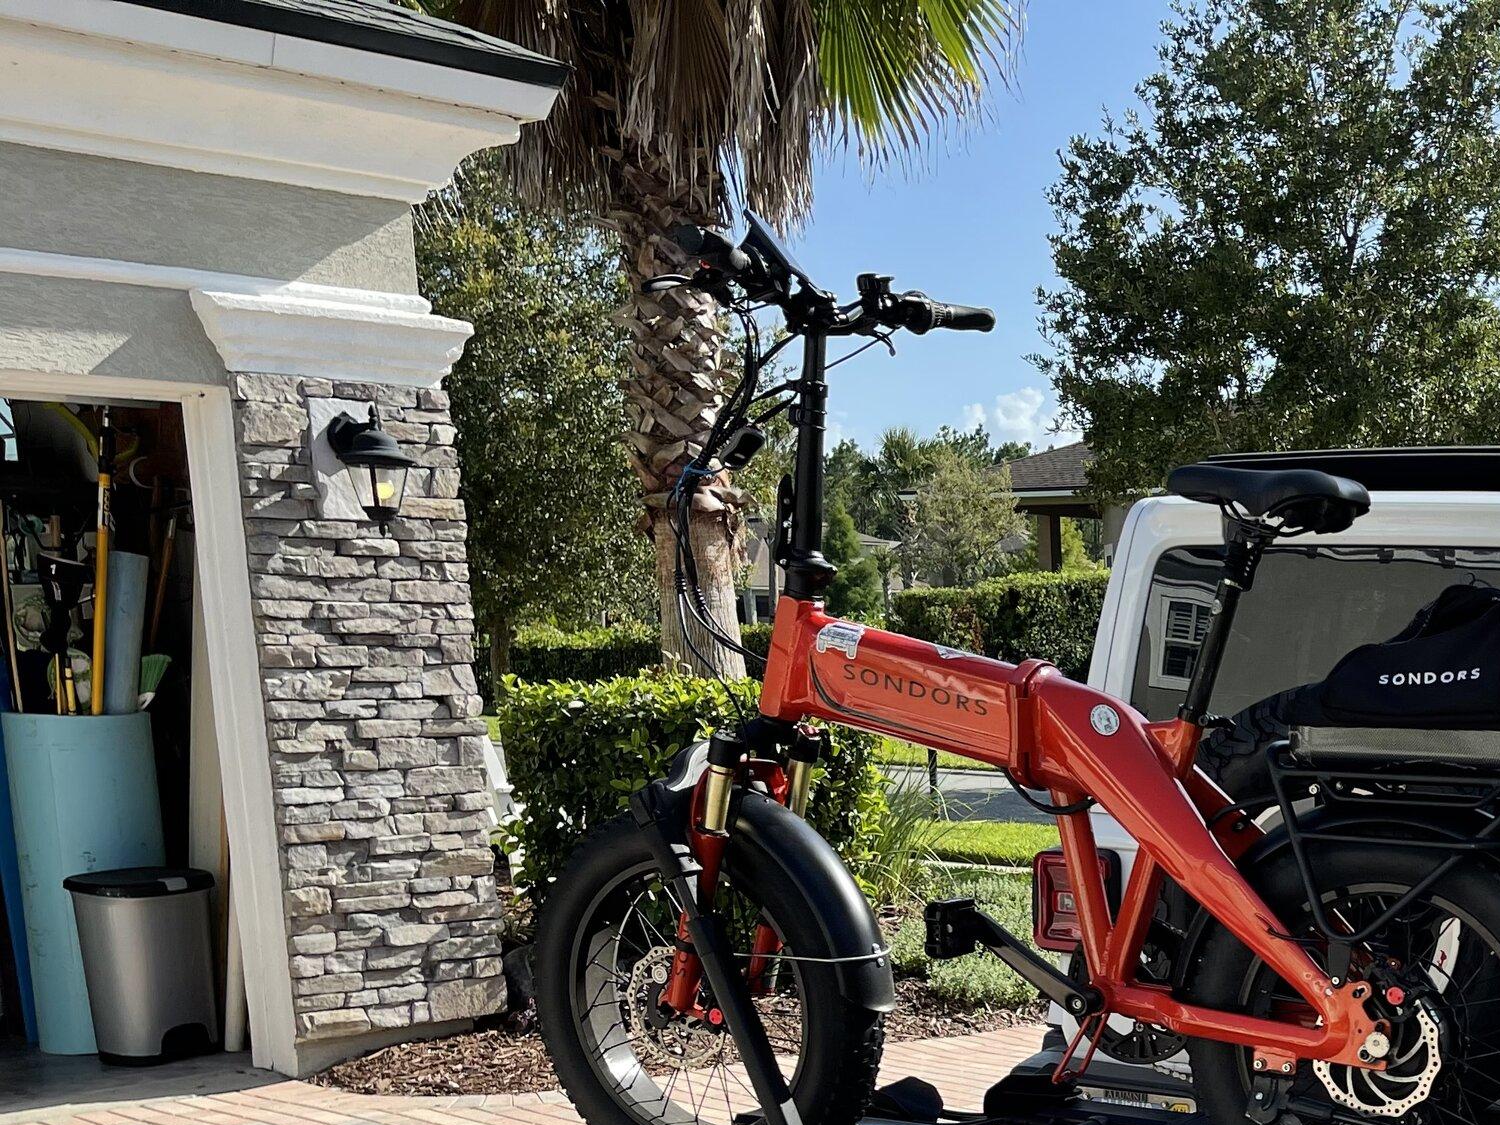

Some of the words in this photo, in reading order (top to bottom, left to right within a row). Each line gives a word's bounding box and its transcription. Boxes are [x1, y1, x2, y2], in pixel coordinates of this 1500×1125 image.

[1379, 667, 1480, 686] SONDORS
[843, 663, 988, 716] SONDORS
[1106, 1089, 1148, 1102] ALUMNI
